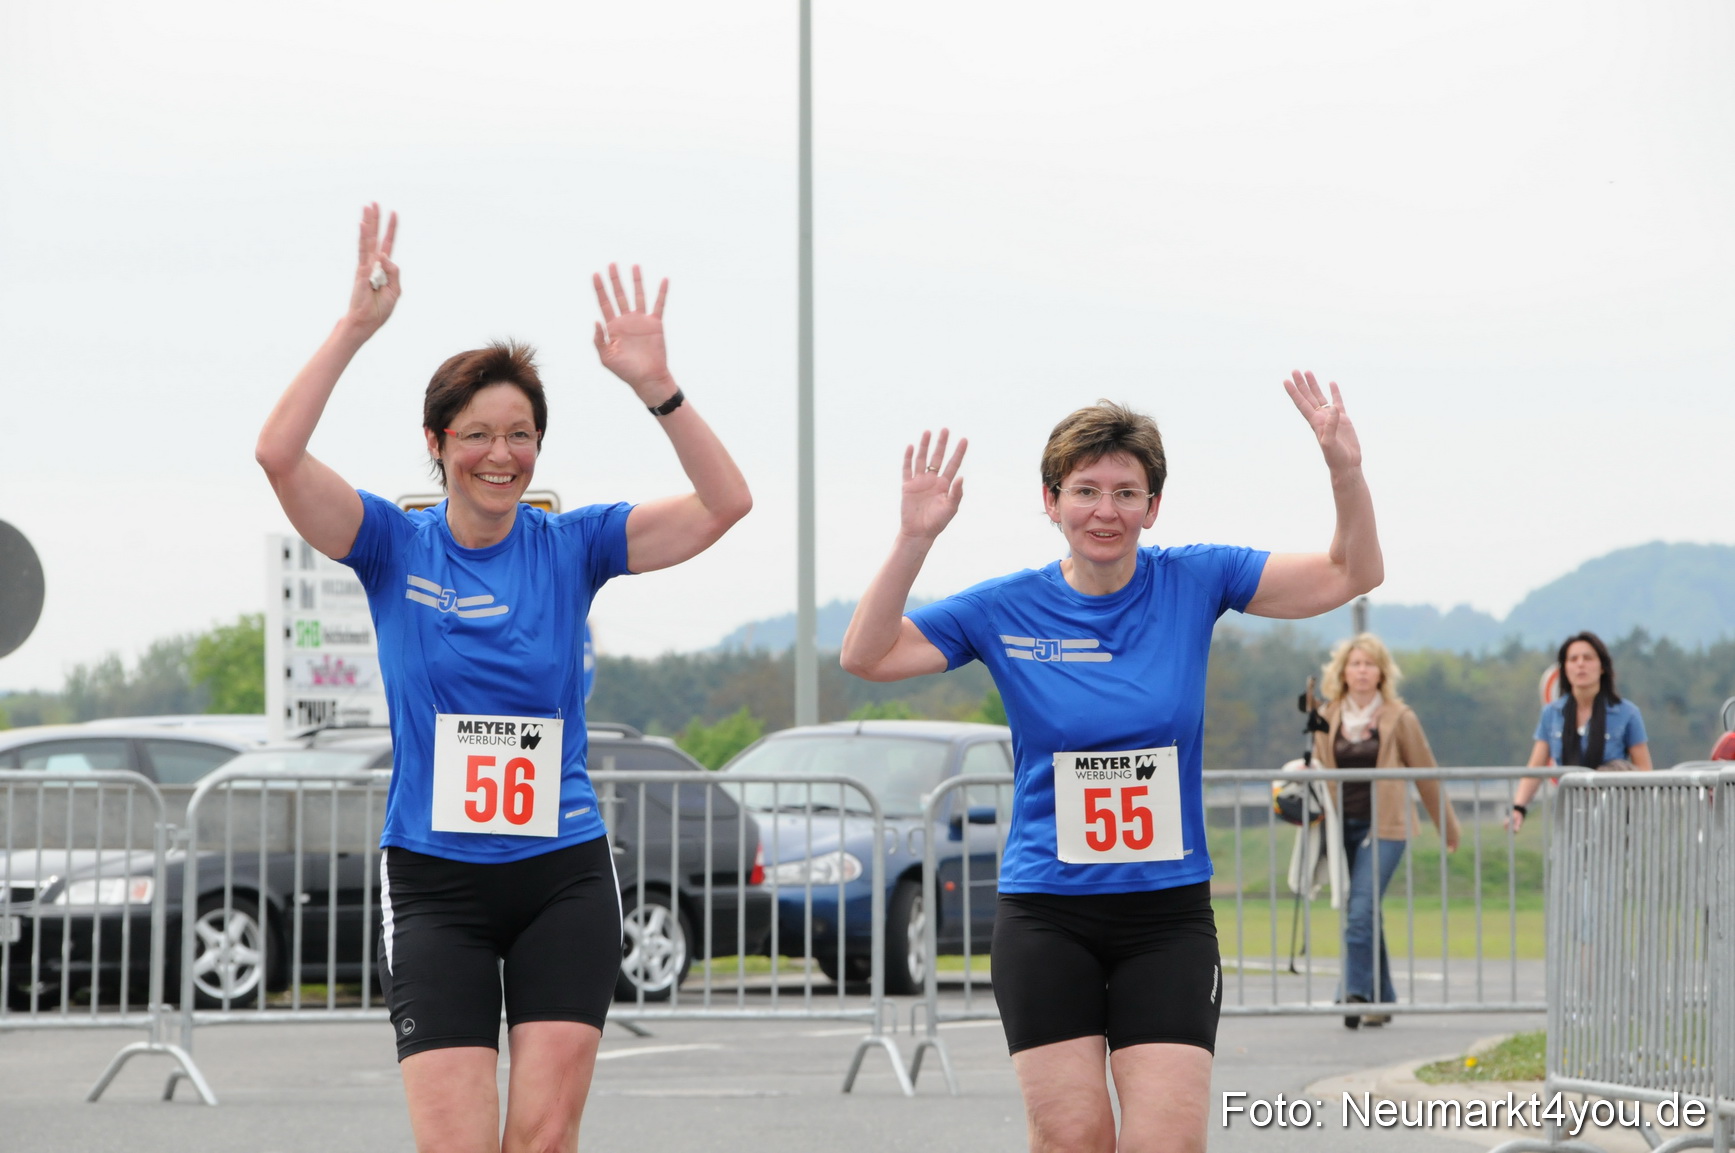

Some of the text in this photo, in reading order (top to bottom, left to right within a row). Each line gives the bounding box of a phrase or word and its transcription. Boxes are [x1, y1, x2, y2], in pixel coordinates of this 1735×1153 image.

[457, 720, 517, 736] MEYER
[457, 734, 517, 747] WERBUNG
[1074, 756, 1132, 770] MEYER
[1074, 769, 1133, 781] WERBUNG
[464, 754, 536, 826] 56
[1083, 785, 1154, 852] 55
